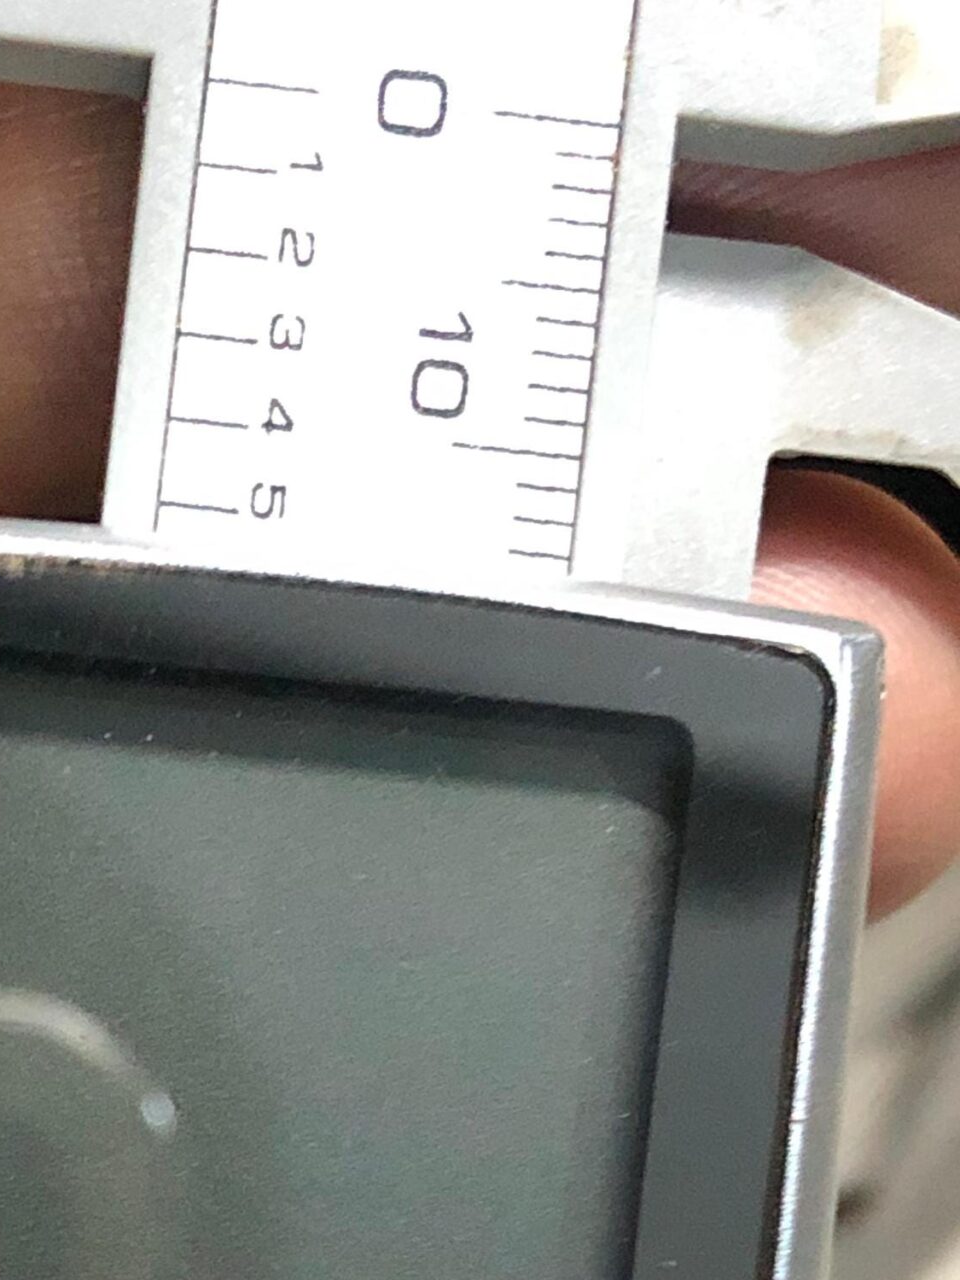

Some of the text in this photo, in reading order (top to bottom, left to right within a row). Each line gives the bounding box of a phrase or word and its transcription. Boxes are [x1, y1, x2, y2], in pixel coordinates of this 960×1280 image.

[377, 68, 448, 138] 0
[289, 151, 324, 172] 1
[277, 226, 316, 268] 2
[269, 312, 307, 352] 3
[410, 311, 474, 419] 10
[260, 397, 294, 434] 4
[249, 482, 287, 520] 5
